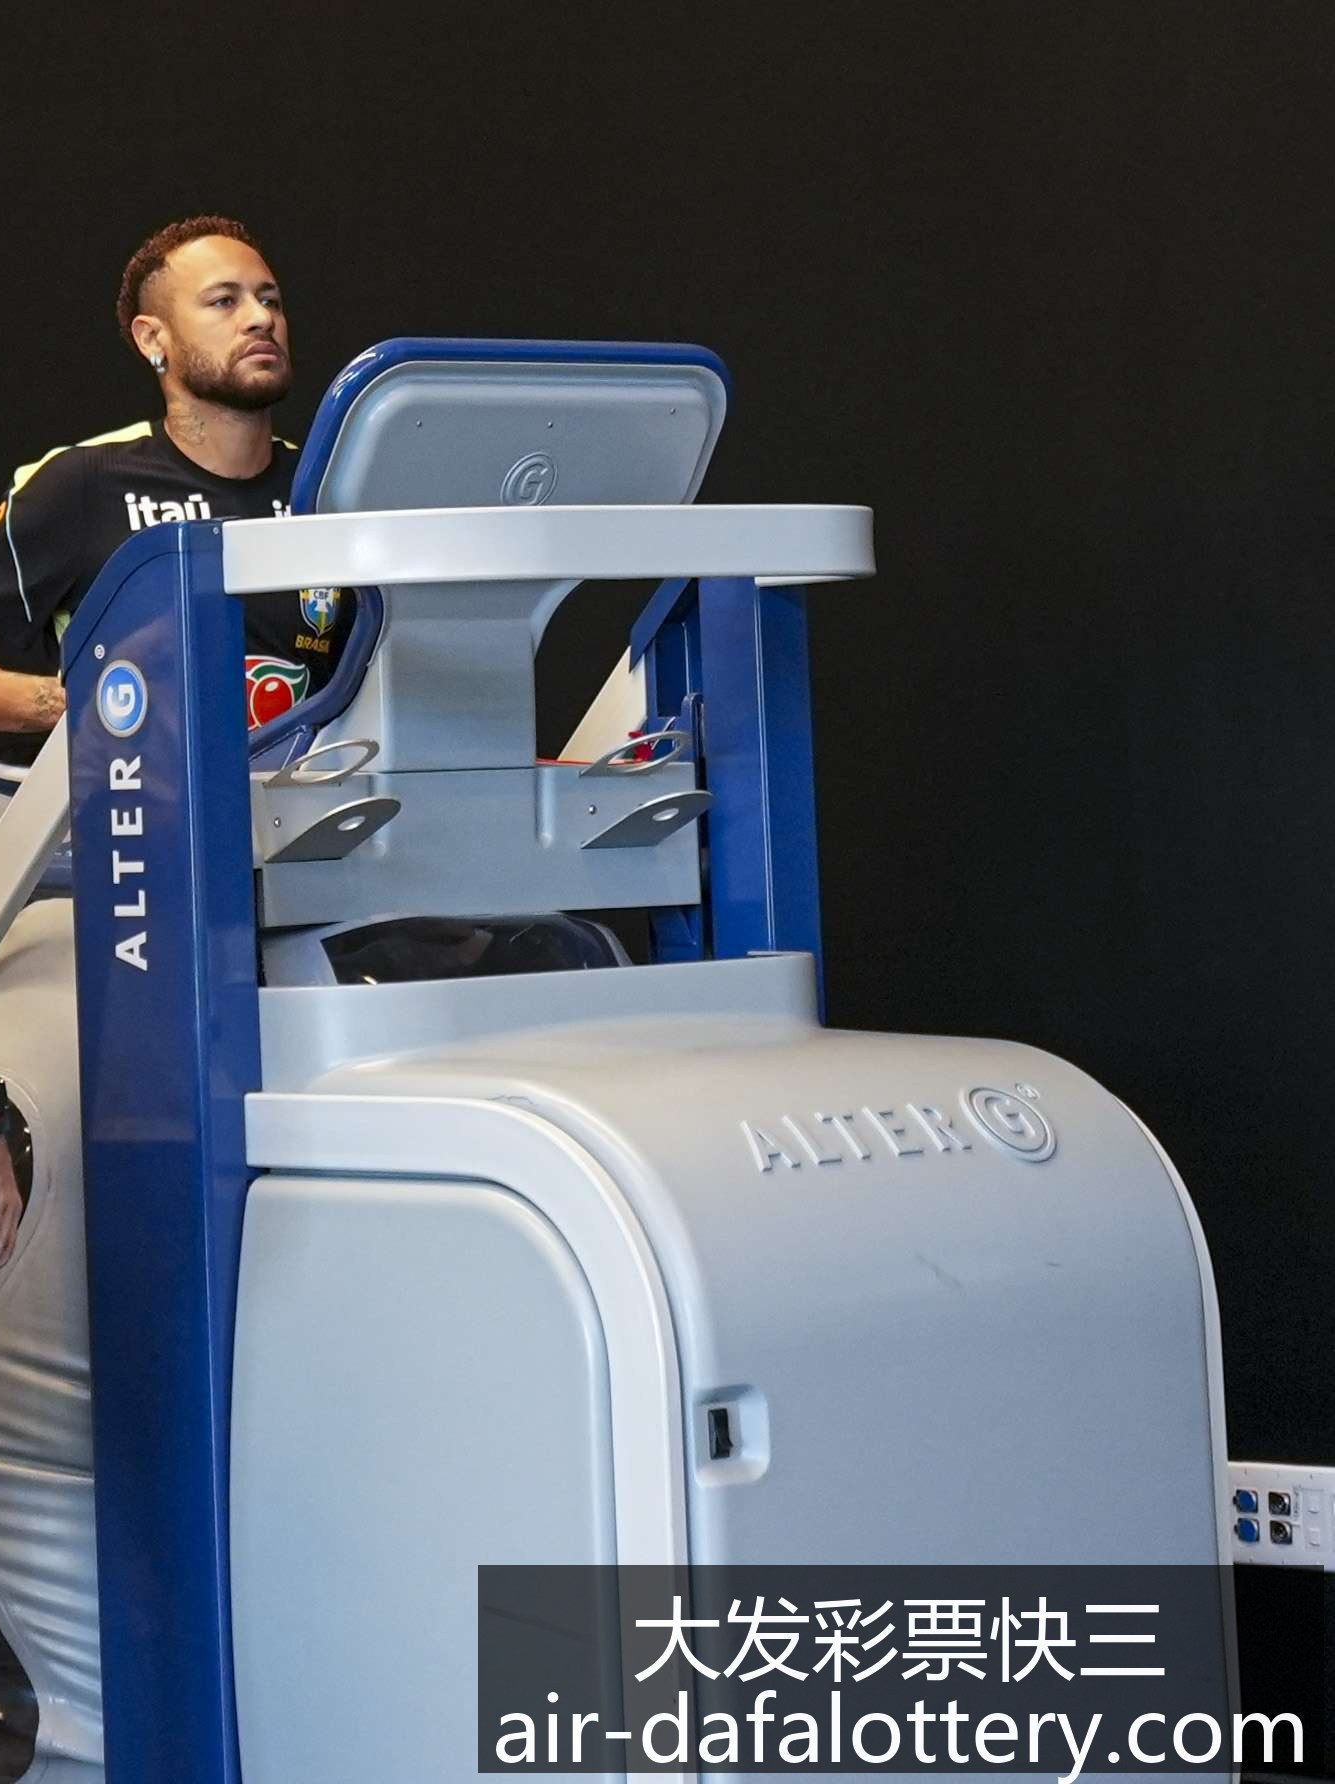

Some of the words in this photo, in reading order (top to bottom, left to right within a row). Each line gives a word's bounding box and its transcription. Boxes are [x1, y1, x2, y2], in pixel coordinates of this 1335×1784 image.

[313, 591, 329, 600] CBF
[109, 755, 148, 972] ALTER
[739, 1103, 973, 1174] ALTER
